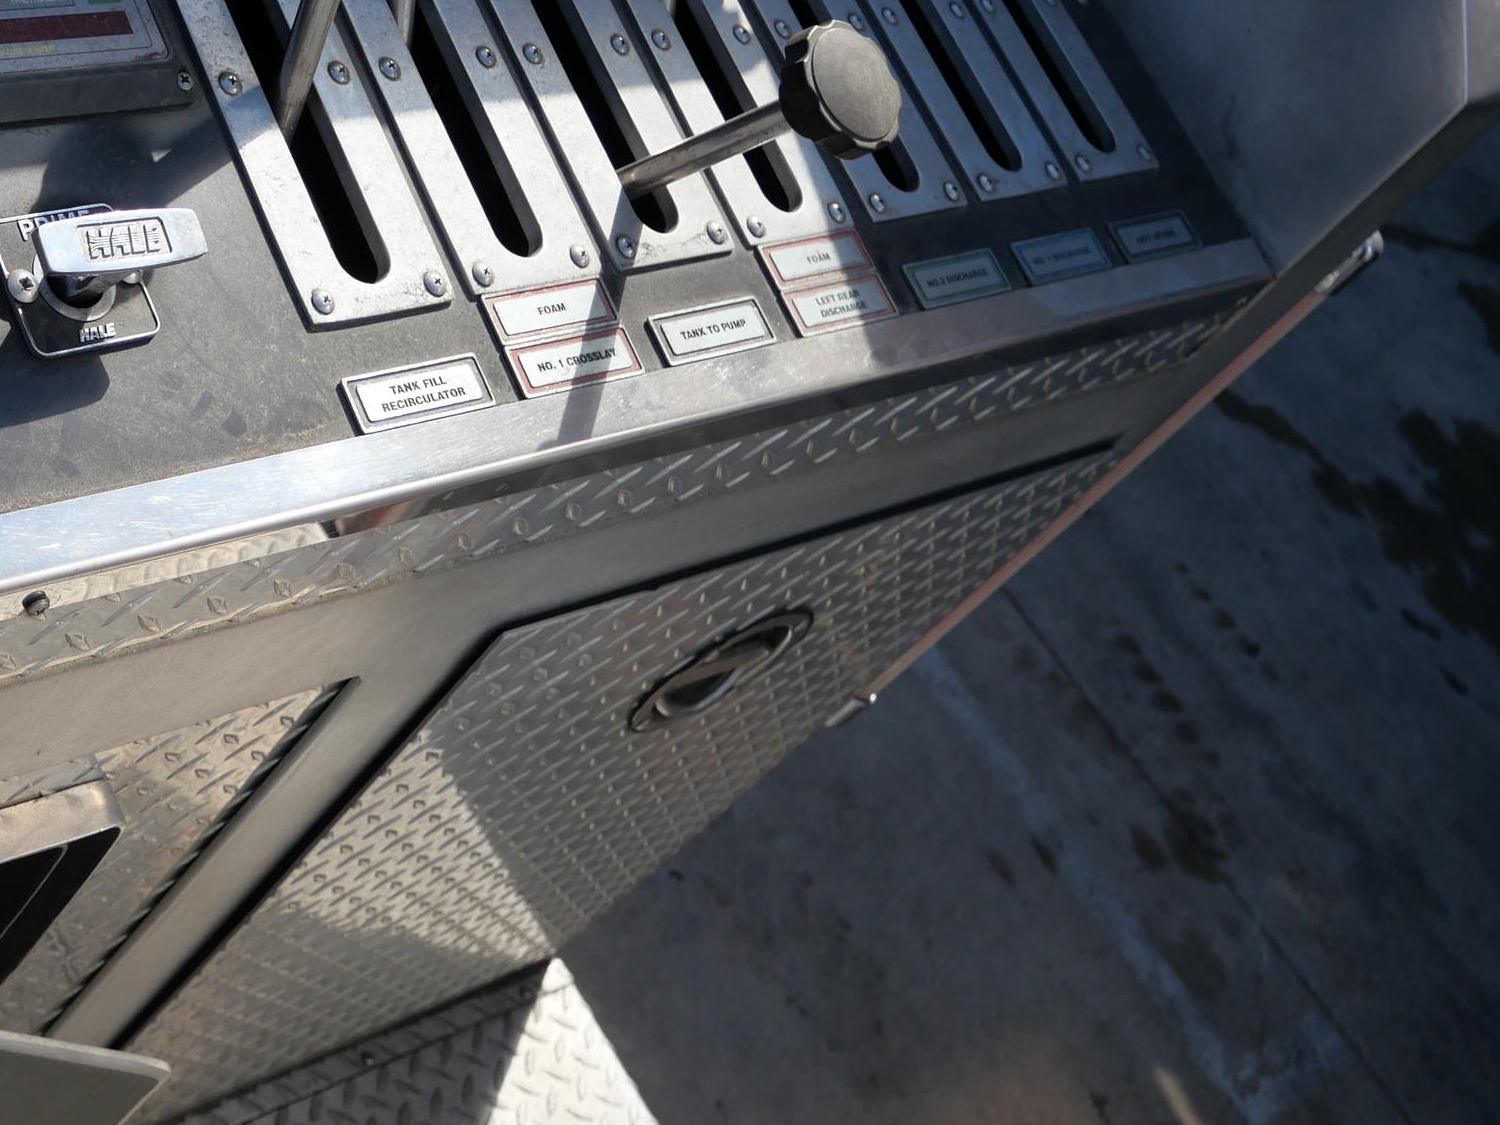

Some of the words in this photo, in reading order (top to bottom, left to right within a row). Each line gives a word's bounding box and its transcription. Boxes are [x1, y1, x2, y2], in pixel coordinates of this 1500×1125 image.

[85, 224, 161, 260] HALE
[806, 252, 830, 264] FOAM
[815, 294, 836, 305] LEFT
[837, 289, 860, 301] REAR
[538, 303, 566, 315] FOAM
[821, 301, 868, 317] DISCHARGE
[79, 322, 116, 342] HALE
[680, 328, 706, 340] TANK
[708, 324, 720, 334] TO
[722, 319, 746, 330] PUMP
[537, 361, 556, 372] NO.
[566, 348, 616, 365] CROSSLAY
[390, 382, 420, 395] TANK
[422, 376, 447, 388] FILL
[381, 386, 466, 413] RECIRCULATOR
